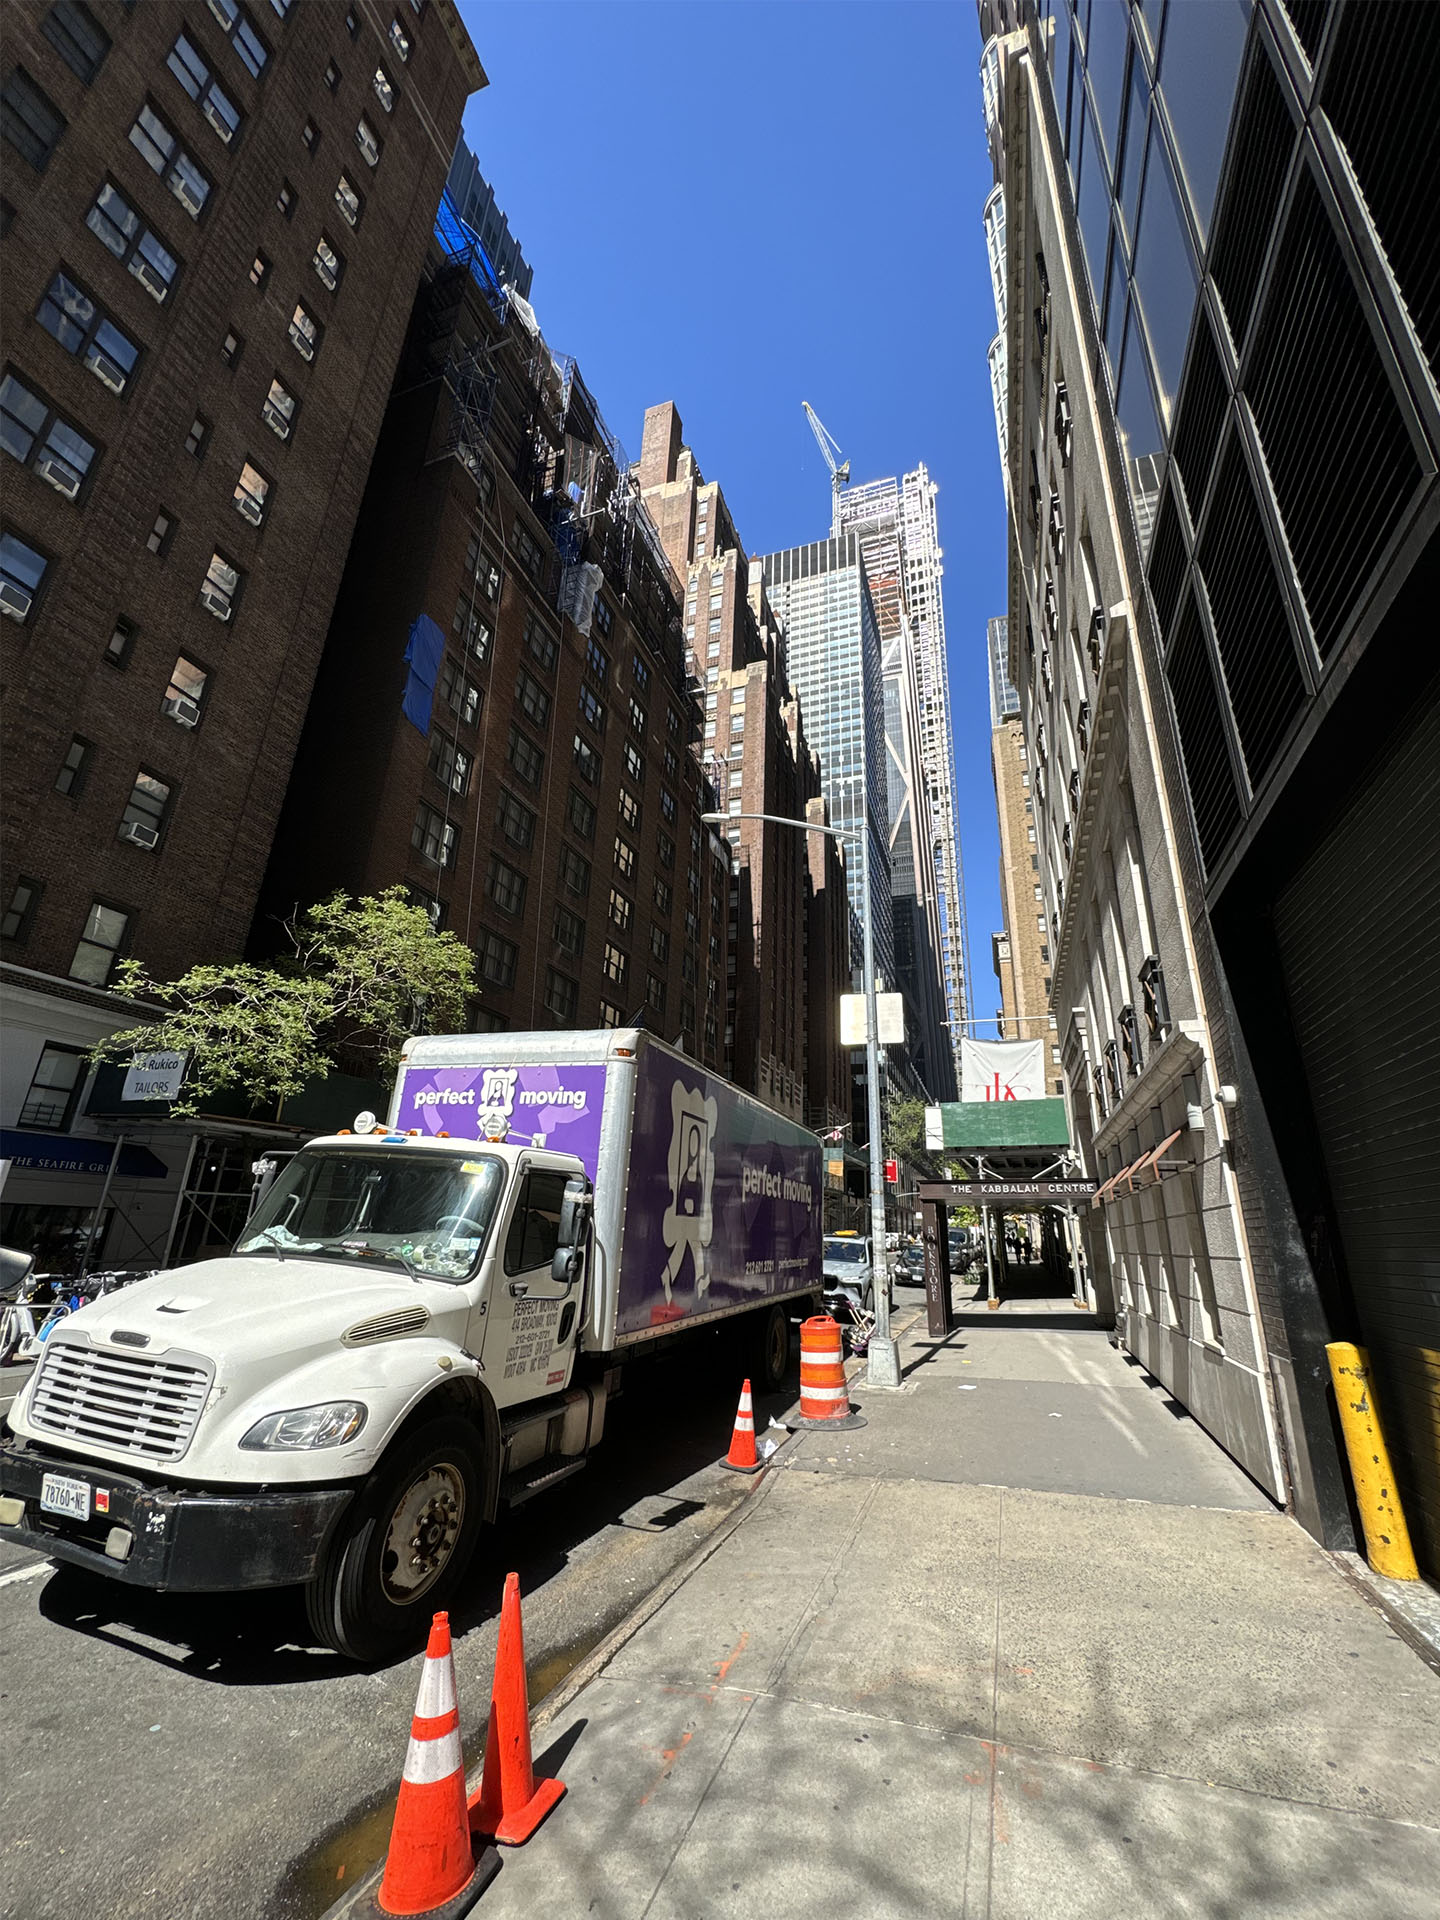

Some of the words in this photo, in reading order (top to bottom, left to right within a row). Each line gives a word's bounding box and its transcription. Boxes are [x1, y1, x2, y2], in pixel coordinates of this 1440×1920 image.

[148, 1058, 179, 1070] Rukico
[134, 1081, 170, 1094] TAILORS
[414, 1087, 476, 1110] perfect
[519, 1086, 587, 1110] moving
[9, 1155, 33, 1167] THE
[37, 1158, 86, 1171] SEAFIRE
[88, 1163, 121, 1174] GRIL
[742, 1164, 782, 1203] perfect
[783, 1175, 812, 1213] moving
[951, 1184, 972, 1194] THE
[981, 1184, 1040, 1194] KABBALAH
[1048, 1183, 1095, 1193] CENTRE
[745, 1261, 755, 1275] 212
[927, 1225, 939, 1302] BOOKSTORE
[480, 1301, 488, 1316] 5
[513, 1300, 539, 1317] PERFECT
[45, 1484, 71, 1507] 78760
